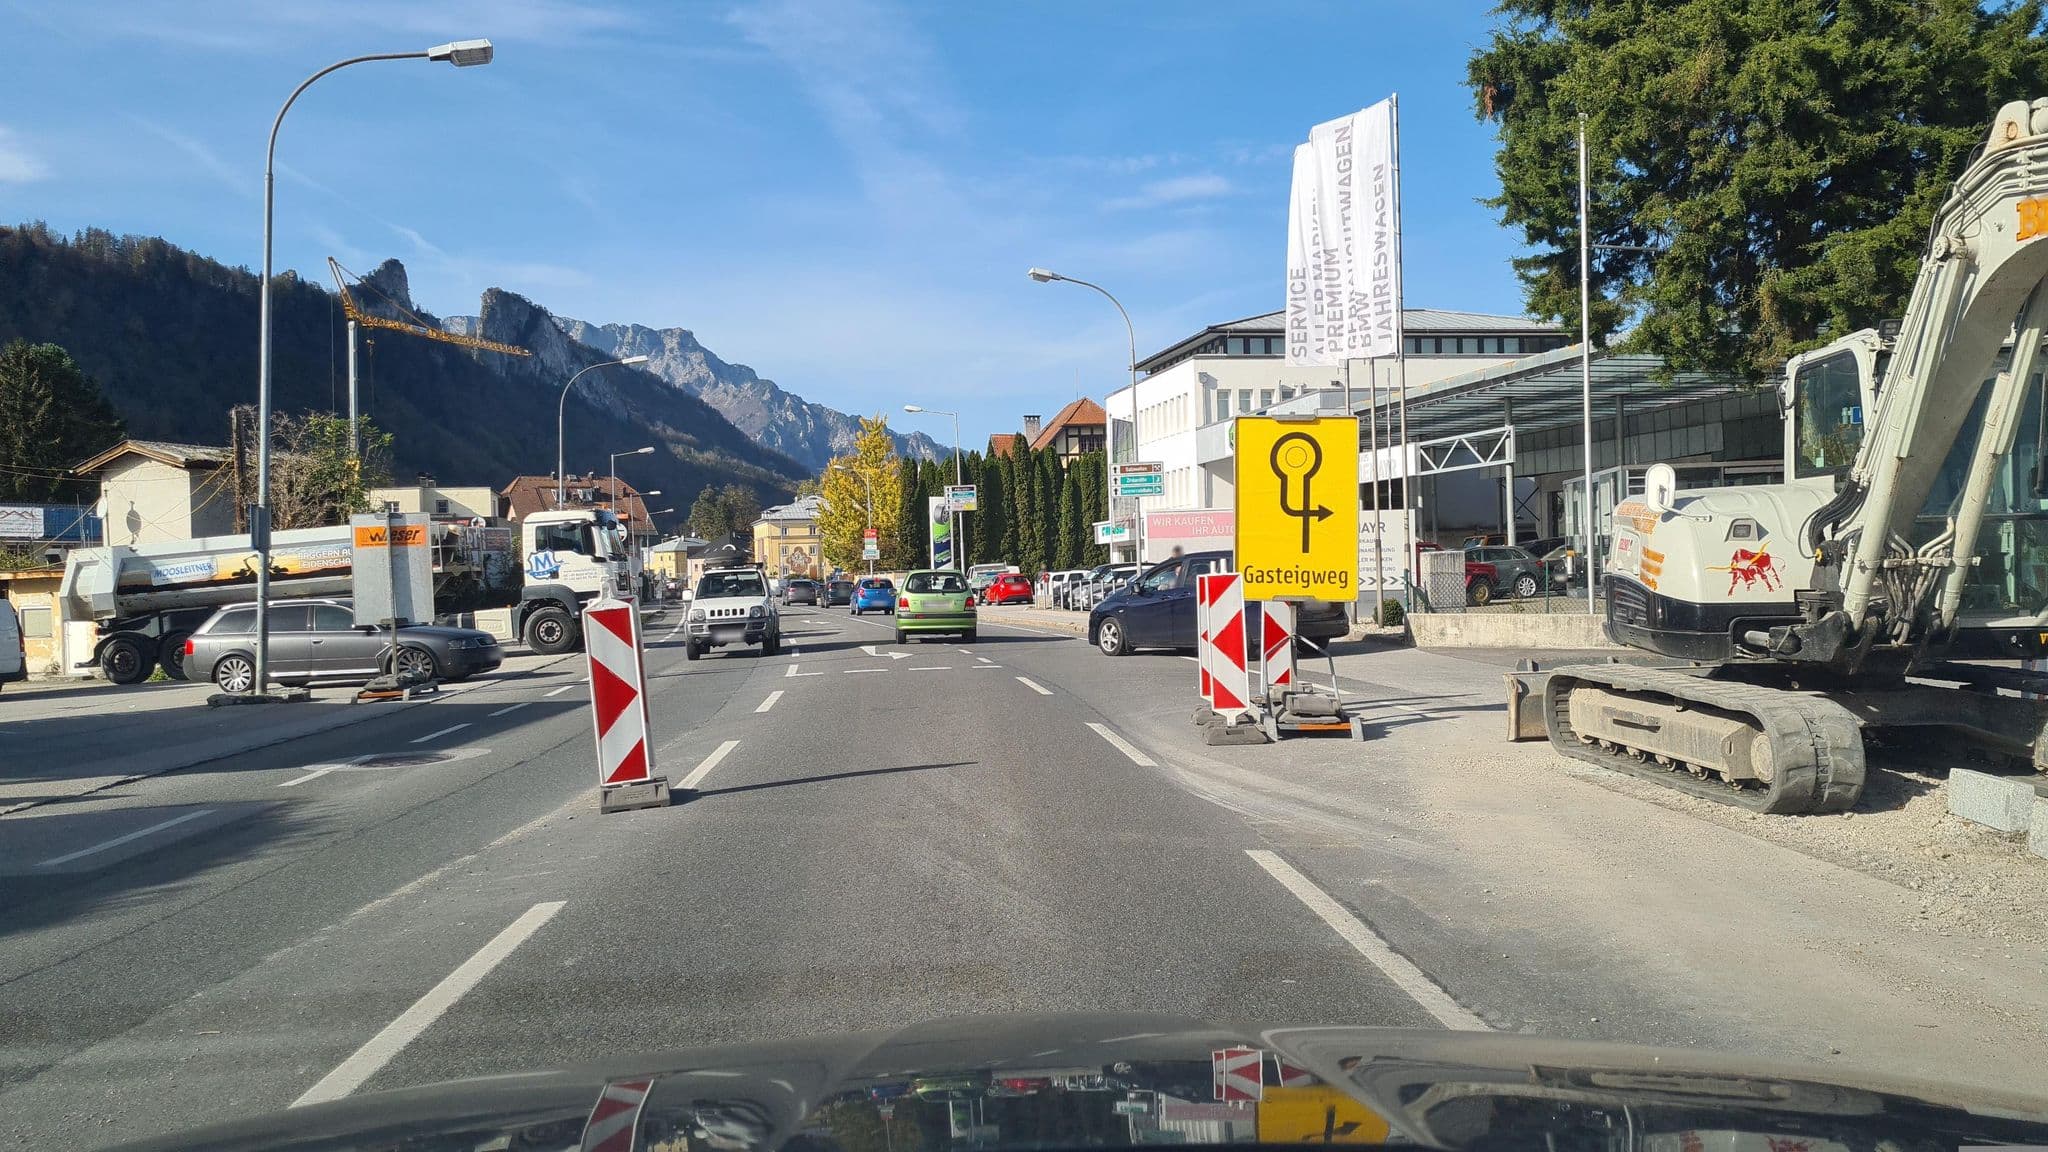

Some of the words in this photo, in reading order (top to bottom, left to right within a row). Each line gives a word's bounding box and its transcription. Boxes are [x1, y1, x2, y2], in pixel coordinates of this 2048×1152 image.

[1323, 247, 1344, 353] PREMIUM
[1290, 267, 1307, 359] SERVICE
[1152, 517, 1172, 527] WIR
[1174, 516, 1214, 526] KAUFEN
[1192, 526, 1209, 535] IHR
[154, 561, 215, 578] MOOSLEITNER
[1244, 564, 1348, 589] Gasteigweg
